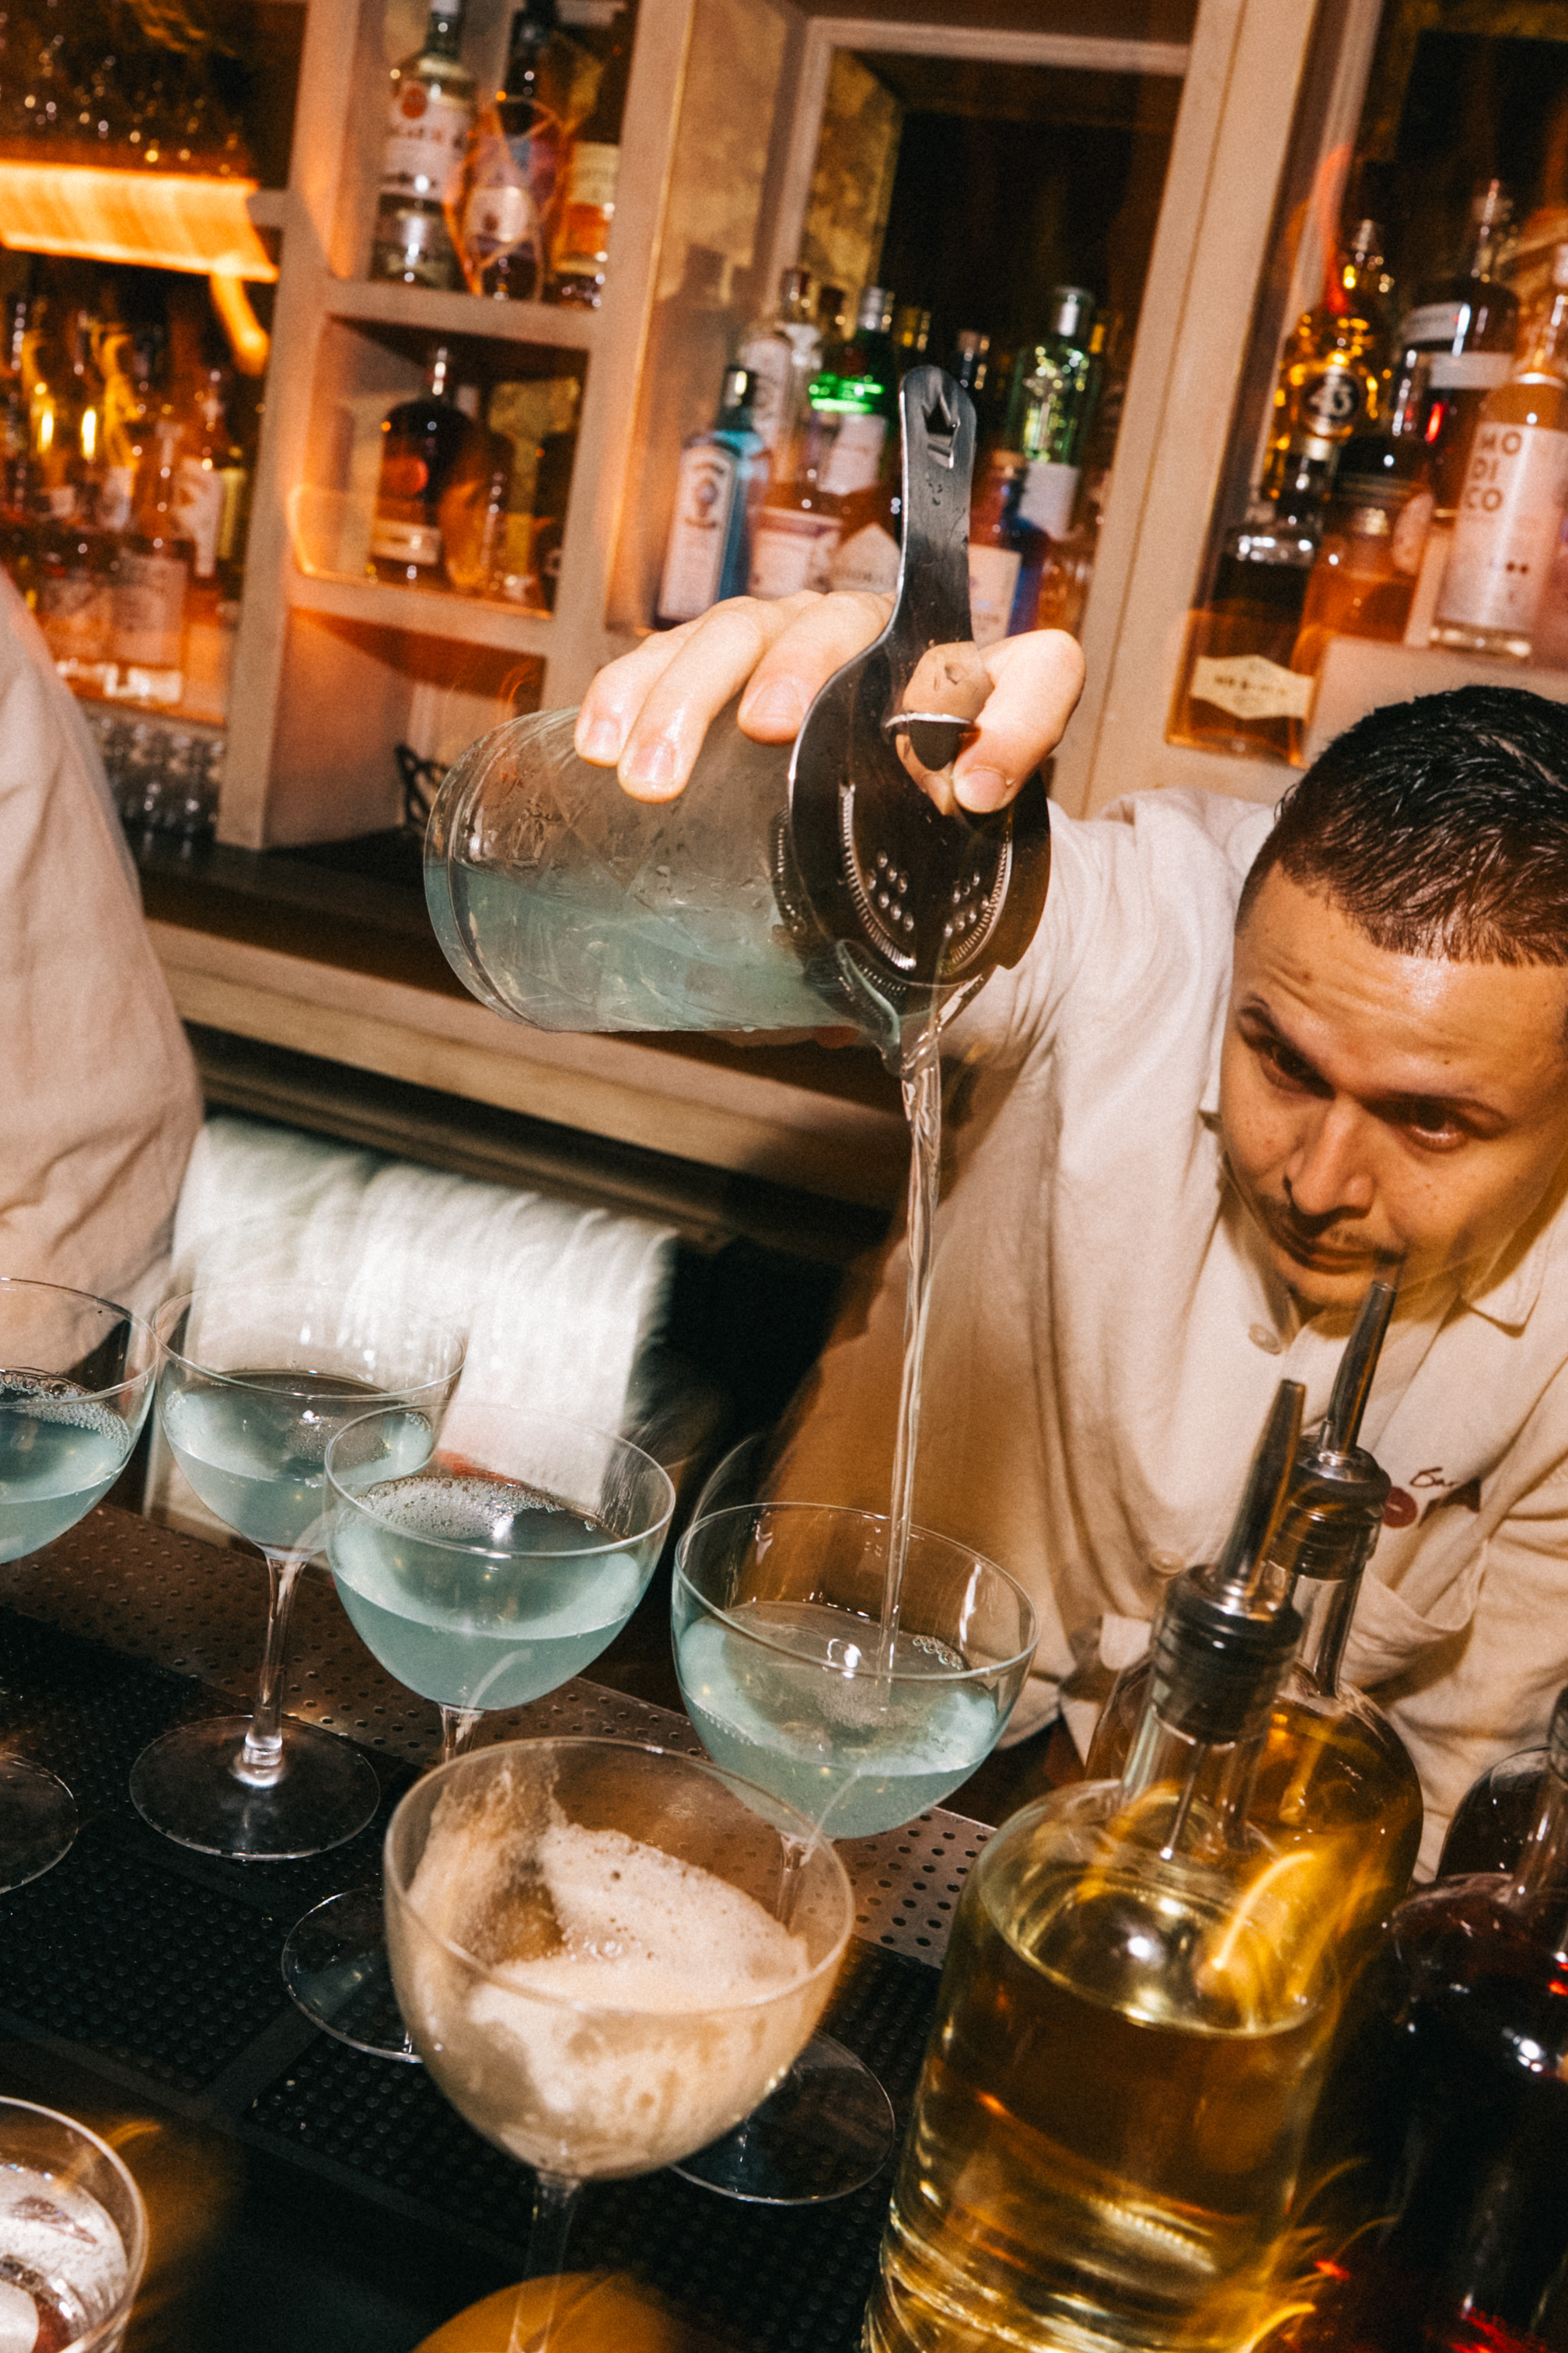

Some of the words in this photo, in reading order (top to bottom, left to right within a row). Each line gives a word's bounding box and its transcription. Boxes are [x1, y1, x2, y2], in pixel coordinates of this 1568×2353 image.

[1481, 432, 1522, 456] MO
[1471, 457, 1499, 481] DI
[1467, 486, 1503, 512] CO
